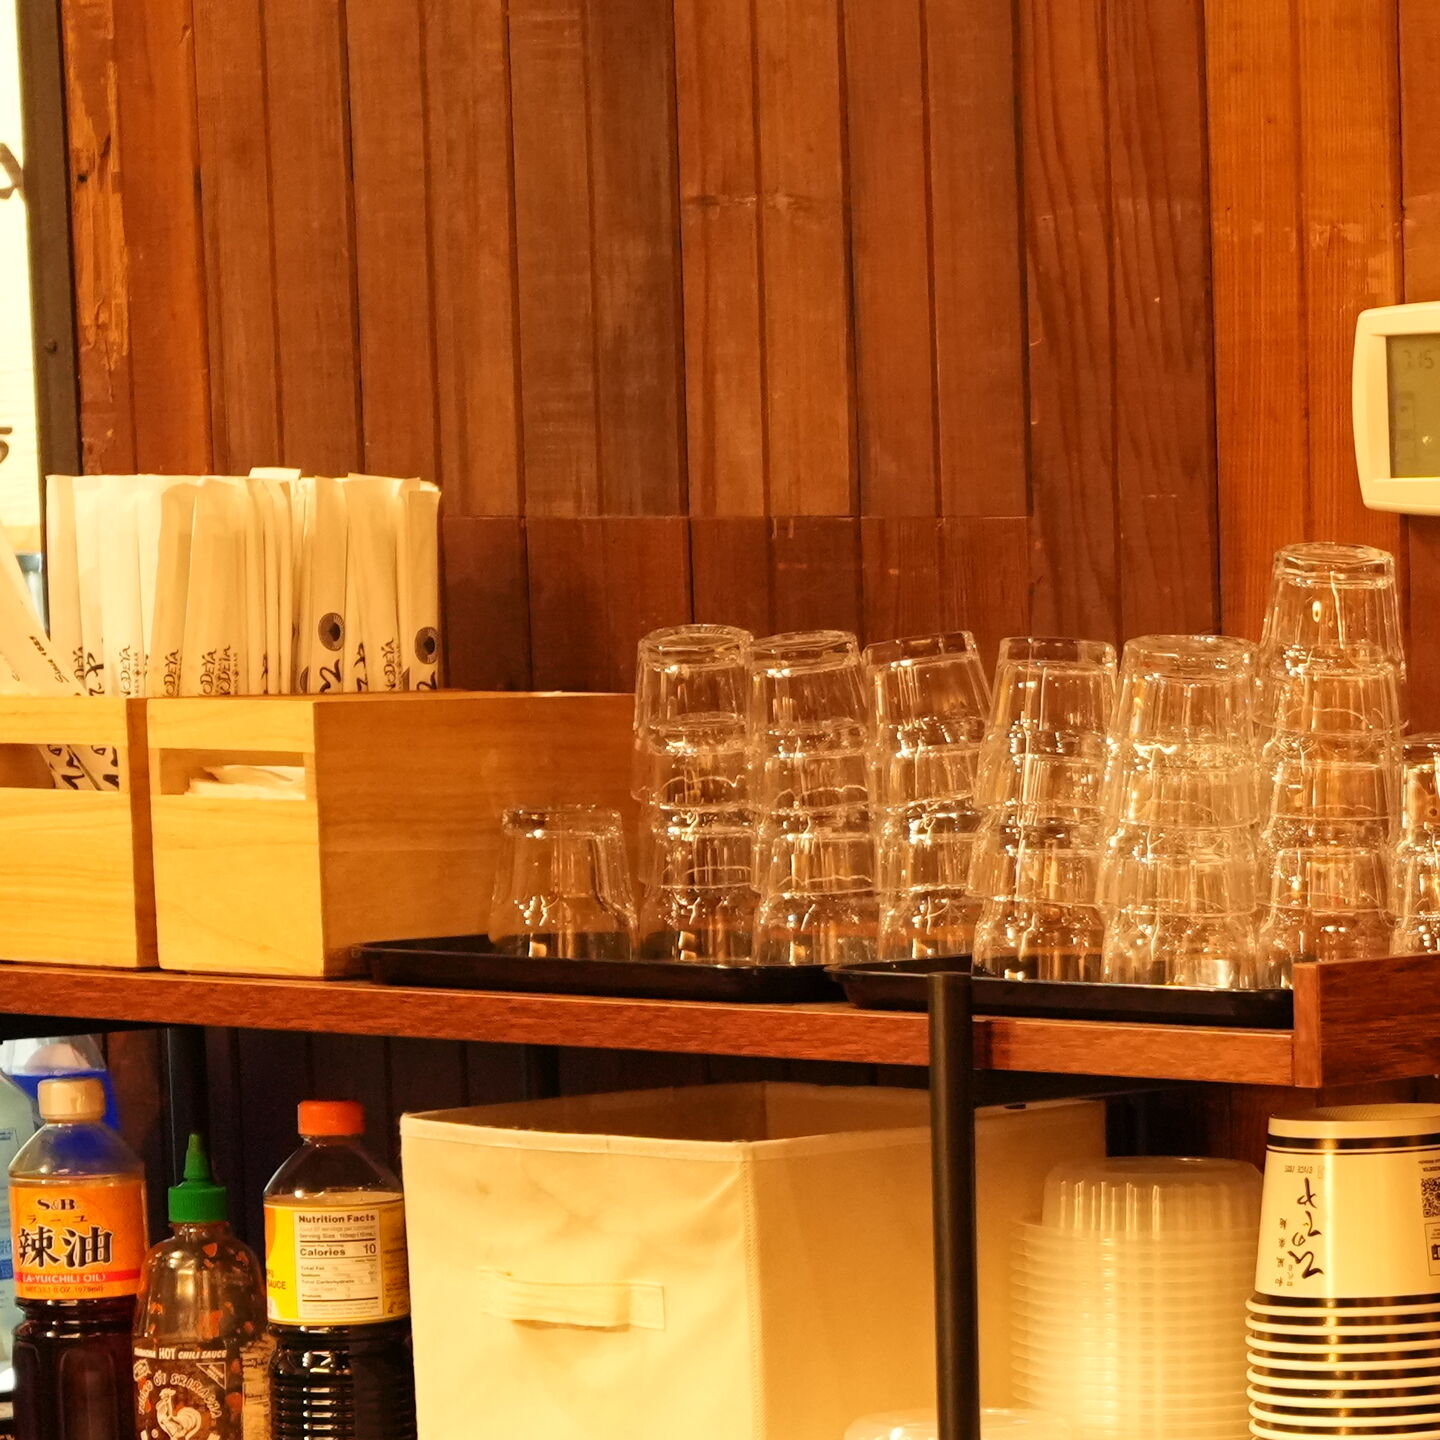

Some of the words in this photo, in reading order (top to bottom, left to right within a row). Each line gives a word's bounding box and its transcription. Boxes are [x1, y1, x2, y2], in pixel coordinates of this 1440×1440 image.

[37, 1198, 76, 1211] S&B
[27, 1214, 88, 1225] ラーユ
[298, 1214, 345, 1224] Nutrition
[346, 1213, 376, 1222] Facts
[18, 1225, 113, 1268] 辣油
[299, 1247, 346, 1257] Calories
[363, 1242, 377, 1255] 10
[158, 1347, 177, 1360] HOT
[178, 1350, 200, 1360] CHILI
[200, 1349, 228, 1359] SAUCE
